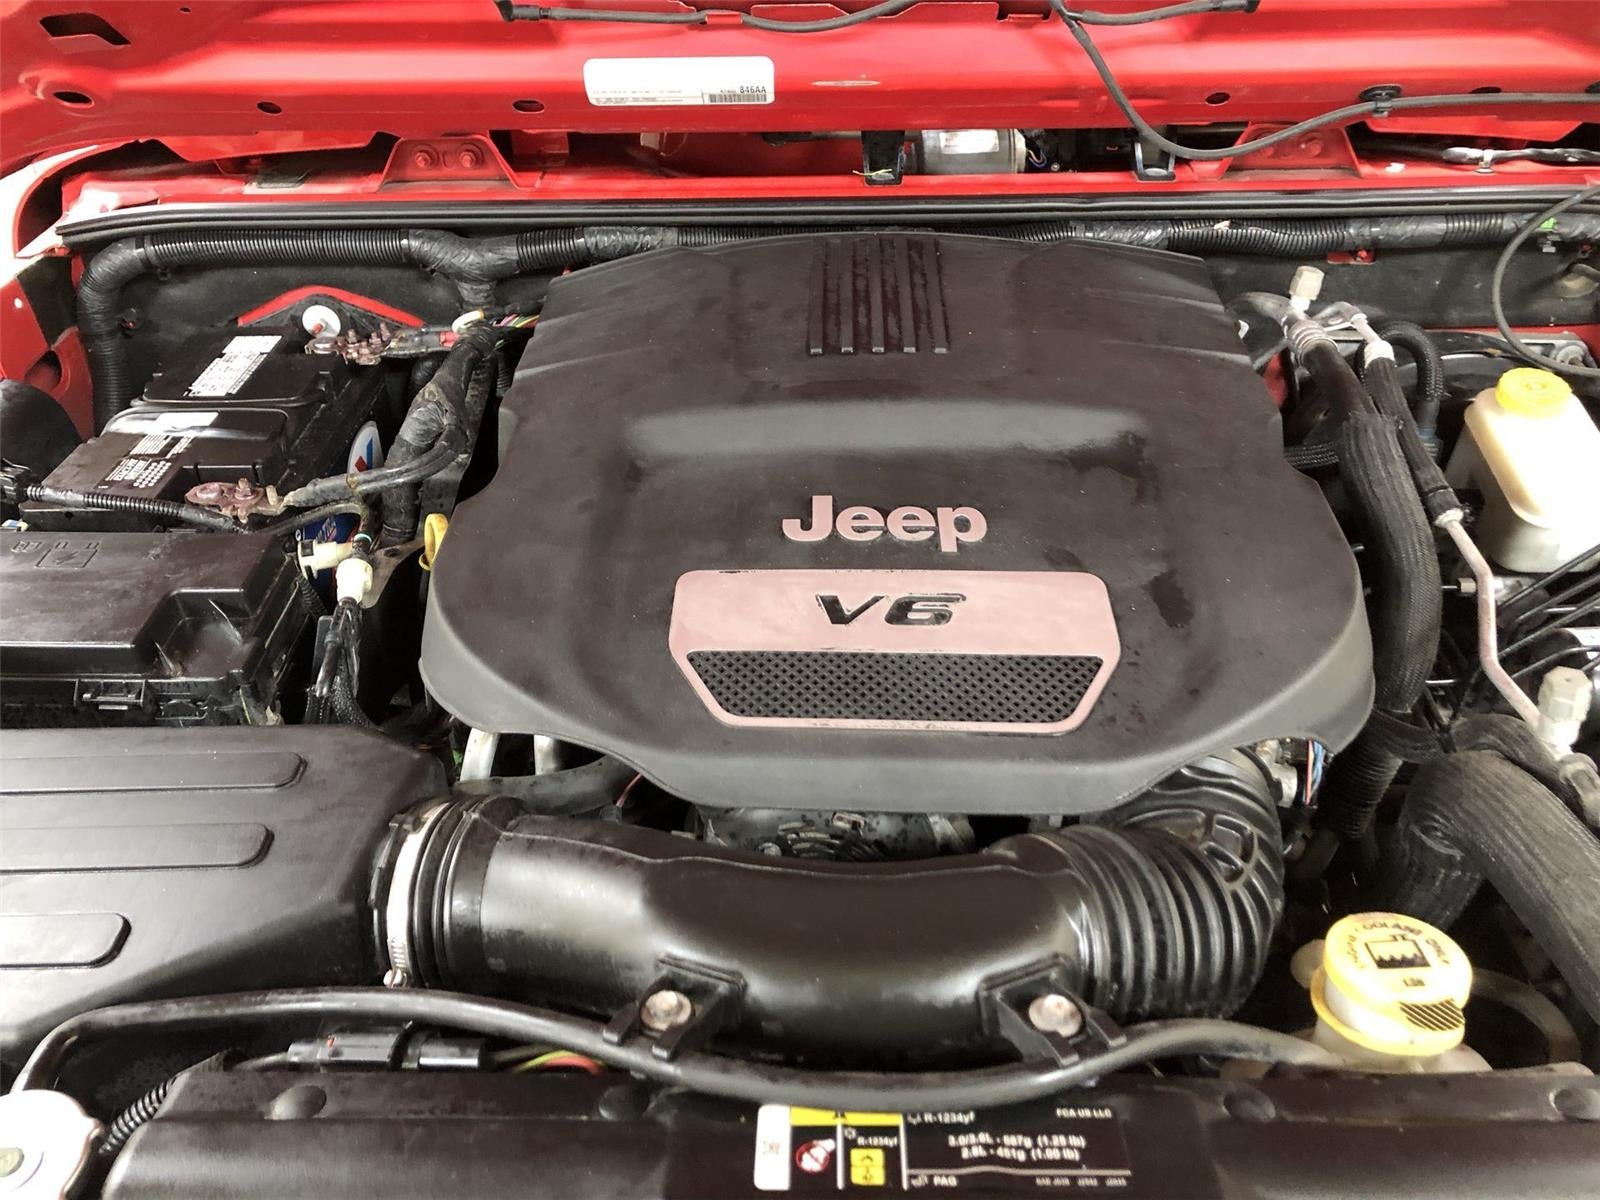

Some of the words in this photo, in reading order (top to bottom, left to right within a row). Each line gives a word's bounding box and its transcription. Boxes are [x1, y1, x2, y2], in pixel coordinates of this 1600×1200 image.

[739, 85, 767, 94] 846AA
[782, 494, 988, 553] Jeep
[814, 592, 967, 626] V6
